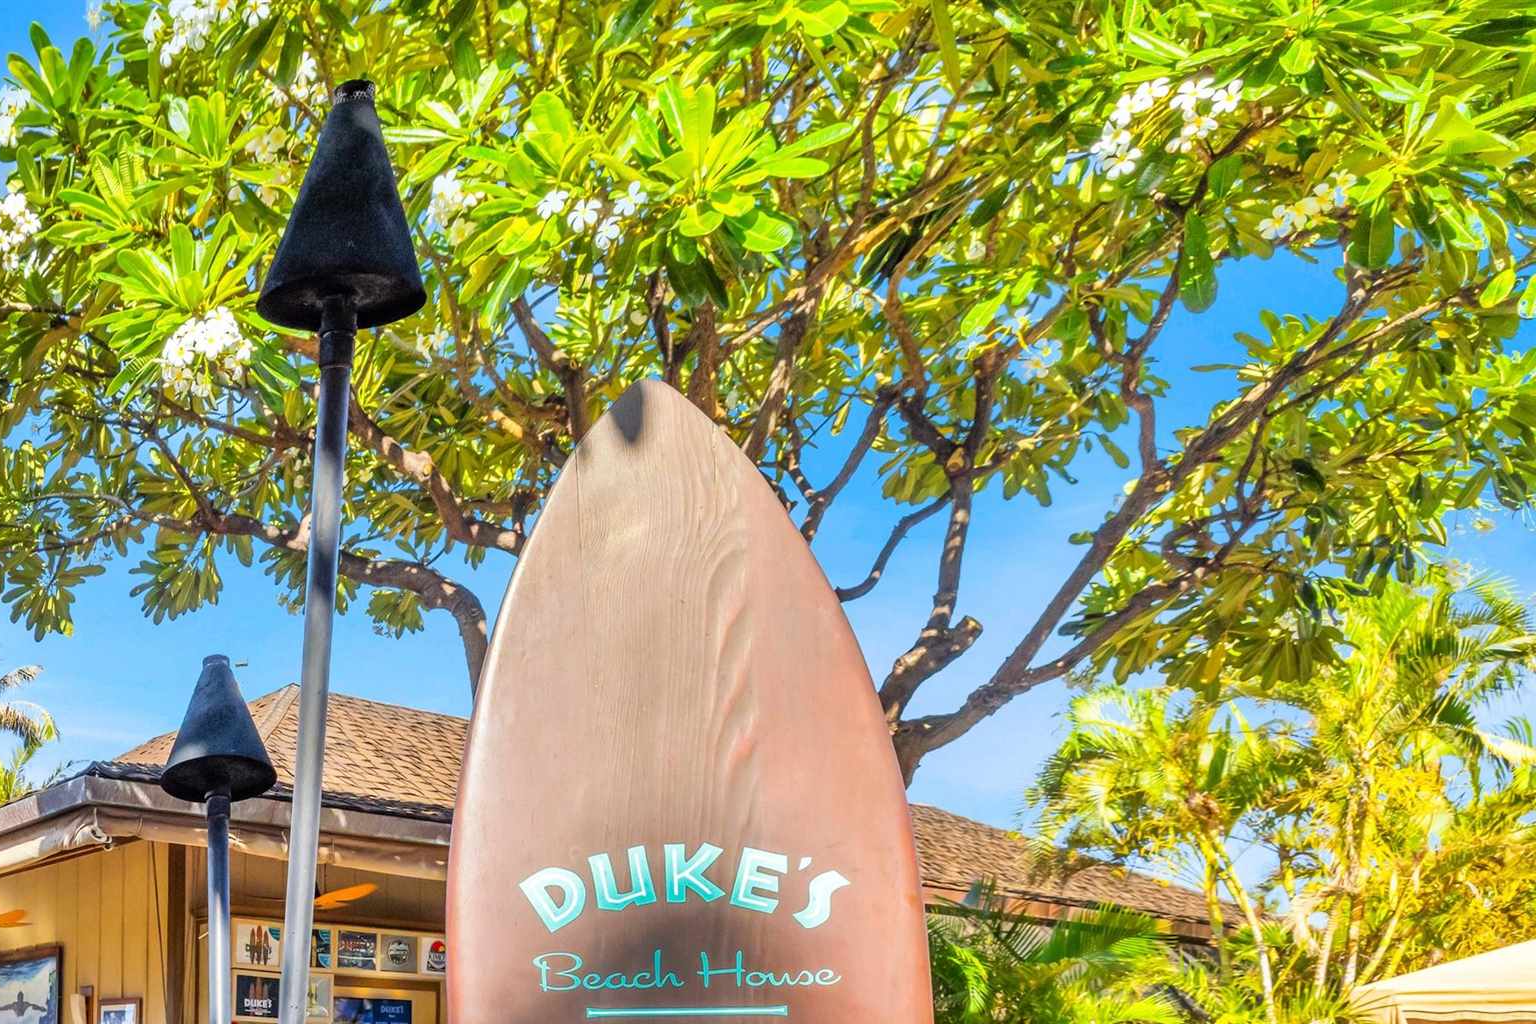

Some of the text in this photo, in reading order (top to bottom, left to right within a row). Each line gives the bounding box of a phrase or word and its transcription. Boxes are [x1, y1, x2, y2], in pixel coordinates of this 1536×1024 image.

[517, 841, 852, 935] DUKE'S
[531, 949, 842, 992] Beach House
